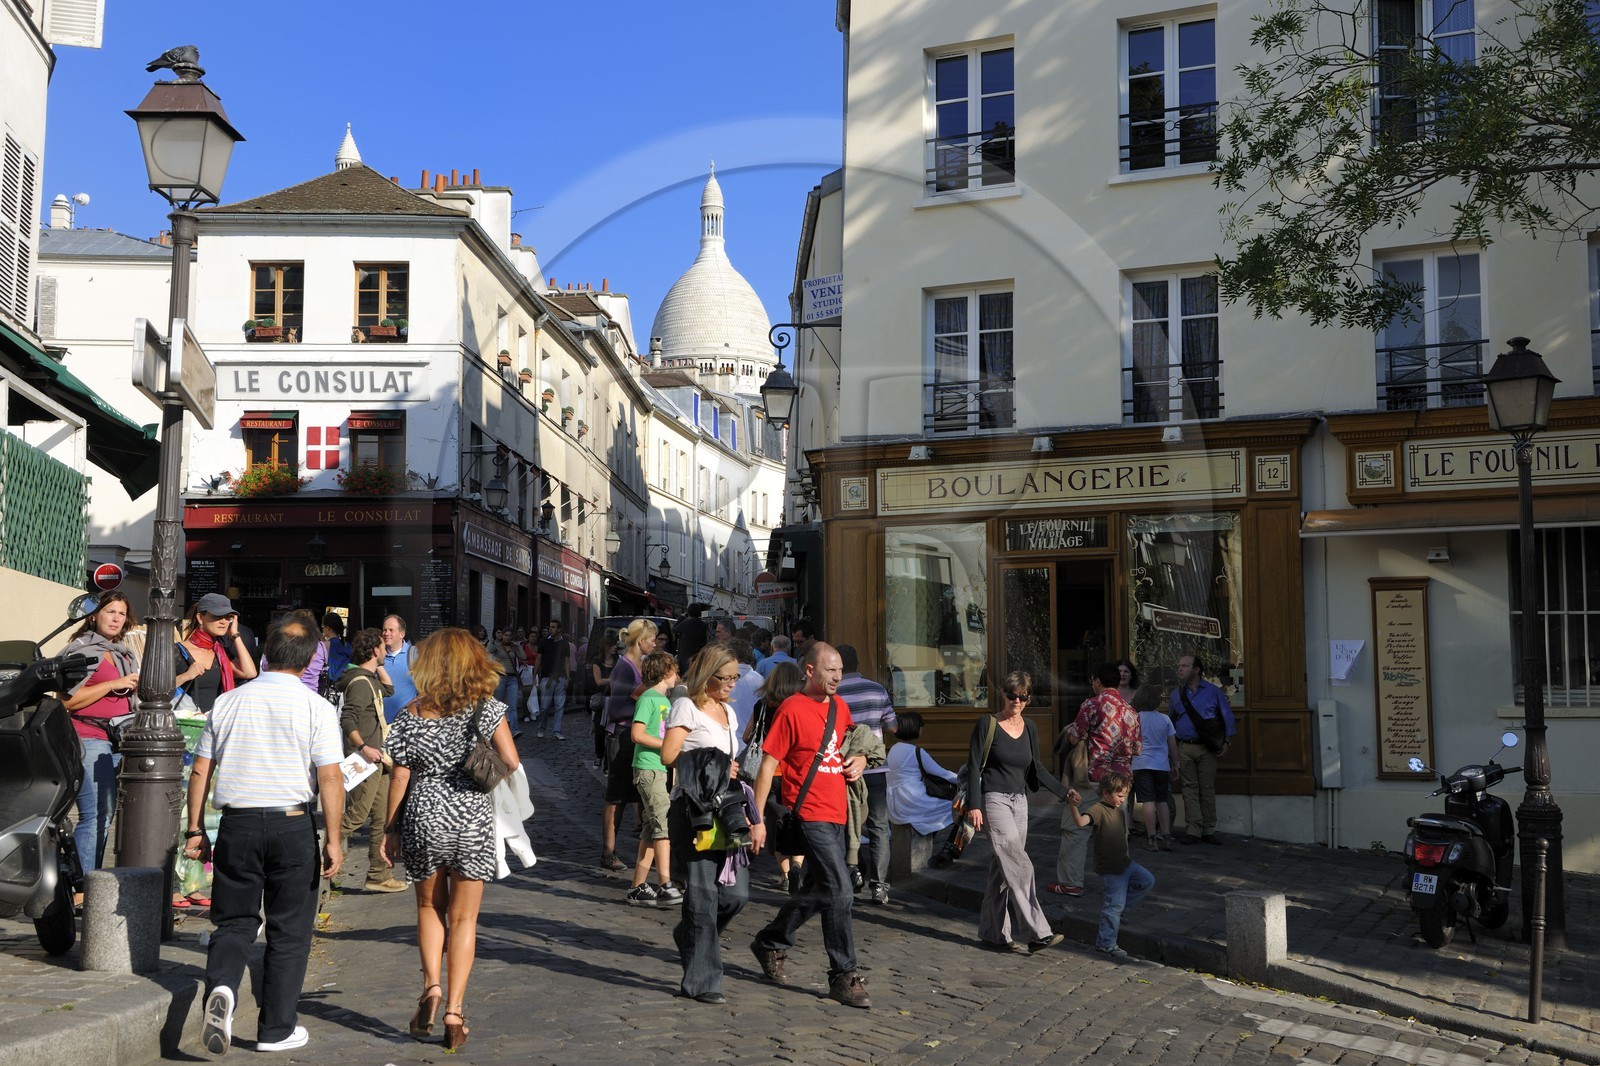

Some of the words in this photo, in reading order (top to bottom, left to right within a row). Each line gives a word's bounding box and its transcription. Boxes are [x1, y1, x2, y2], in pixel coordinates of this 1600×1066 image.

[815, 310, 824, 319] 55
[825, 308, 834, 316] 58
[234, 370, 261, 393] LE
[279, 369, 413, 394] CONSULAT
[246, 420, 286, 428] RESTAURANT
[353, 419, 361, 427] LE
[363, 419, 395, 428] CONSULAT
[1424, 451, 1455, 477] LE
[1469, 444, 1580, 475] FOUNIL
[1267, 467, 1279, 479] 12
[928, 464, 1170, 499] BOULANGERIE
[213, 513, 284, 523] RESTAURANT
[318, 511, 336, 522] LE
[344, 509, 422, 522] CONSULAT
[1019, 522, 1037, 535] LE
[1038, 519, 1091, 532] FOURNIL
[467, 531, 502, 559] AMBASSADE
[505, 544, 512, 562] DE
[1028, 535, 1084, 550] VILLAGE
[304, 563, 337, 577] CAFÉ
